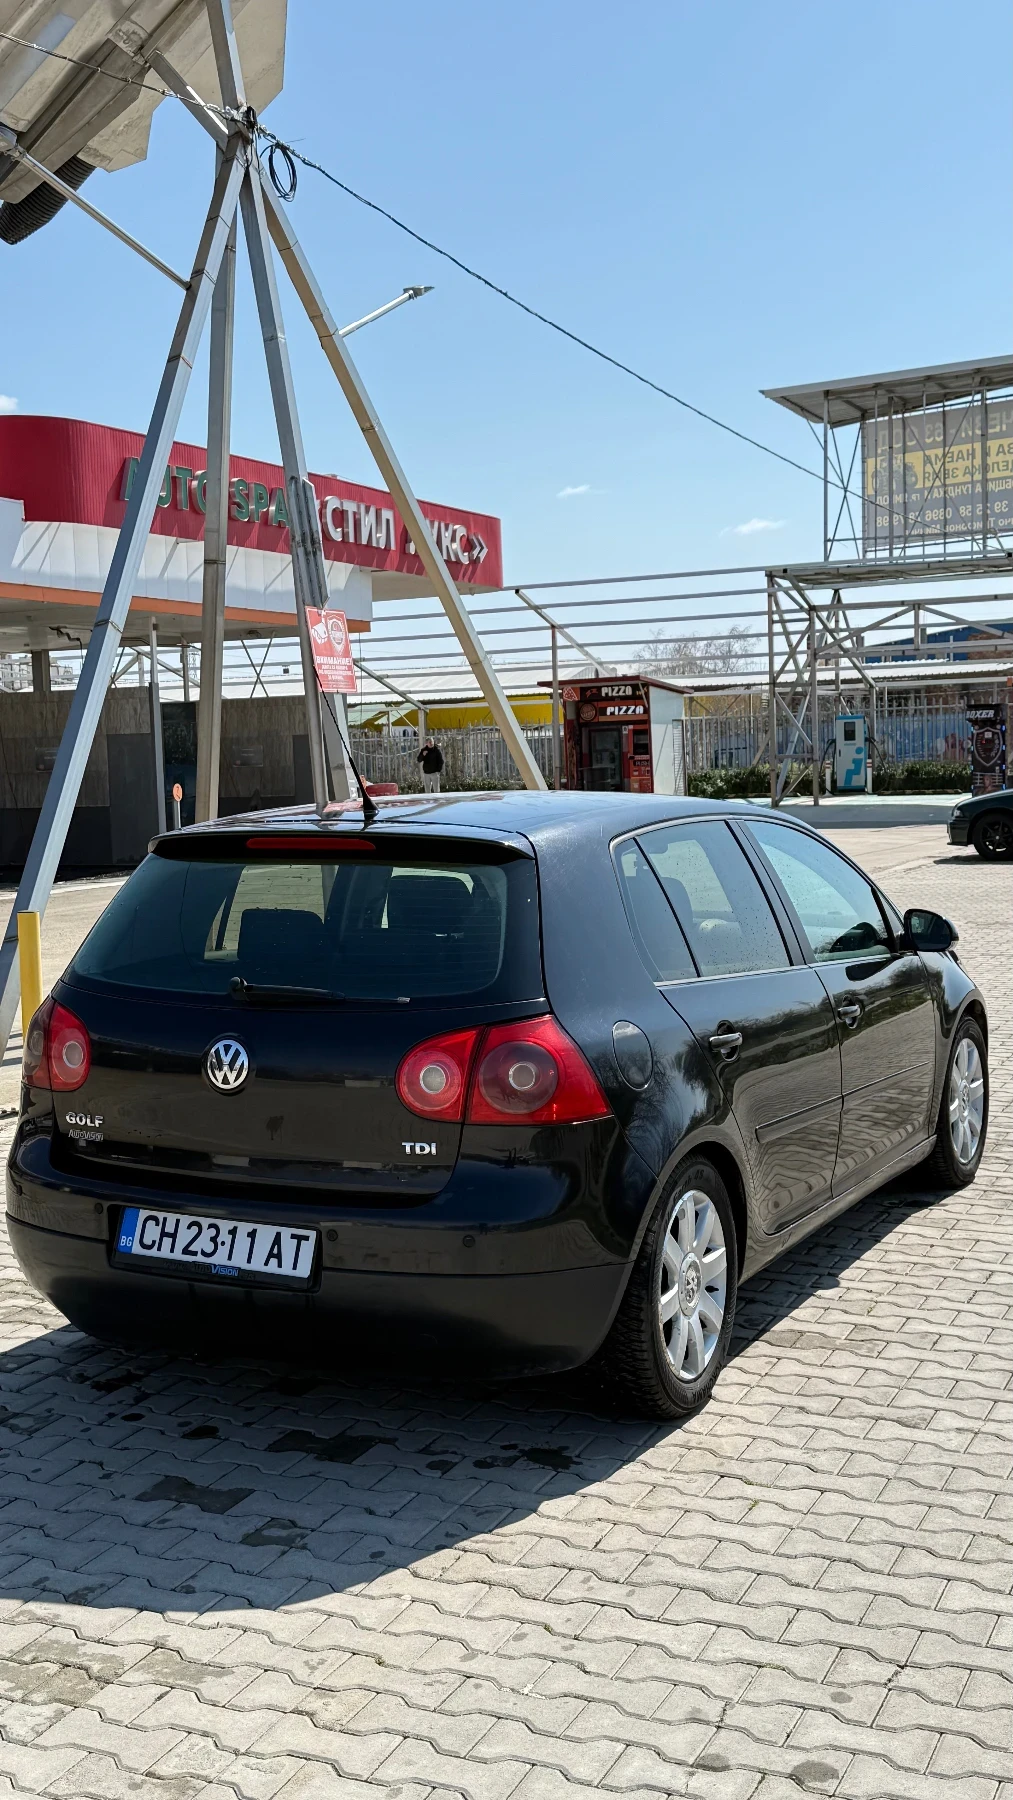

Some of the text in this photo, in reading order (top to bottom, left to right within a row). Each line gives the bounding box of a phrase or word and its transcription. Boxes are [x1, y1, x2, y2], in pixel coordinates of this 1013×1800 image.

[230, 477, 290, 527] SPA
[601, 685, 633, 697] PIZZA
[606, 705, 644, 716] PIZZA
[65, 1111, 104, 1128] GOLF
[401, 1141, 437, 1156] TDI
[120, 1235, 133, 1247] BG
